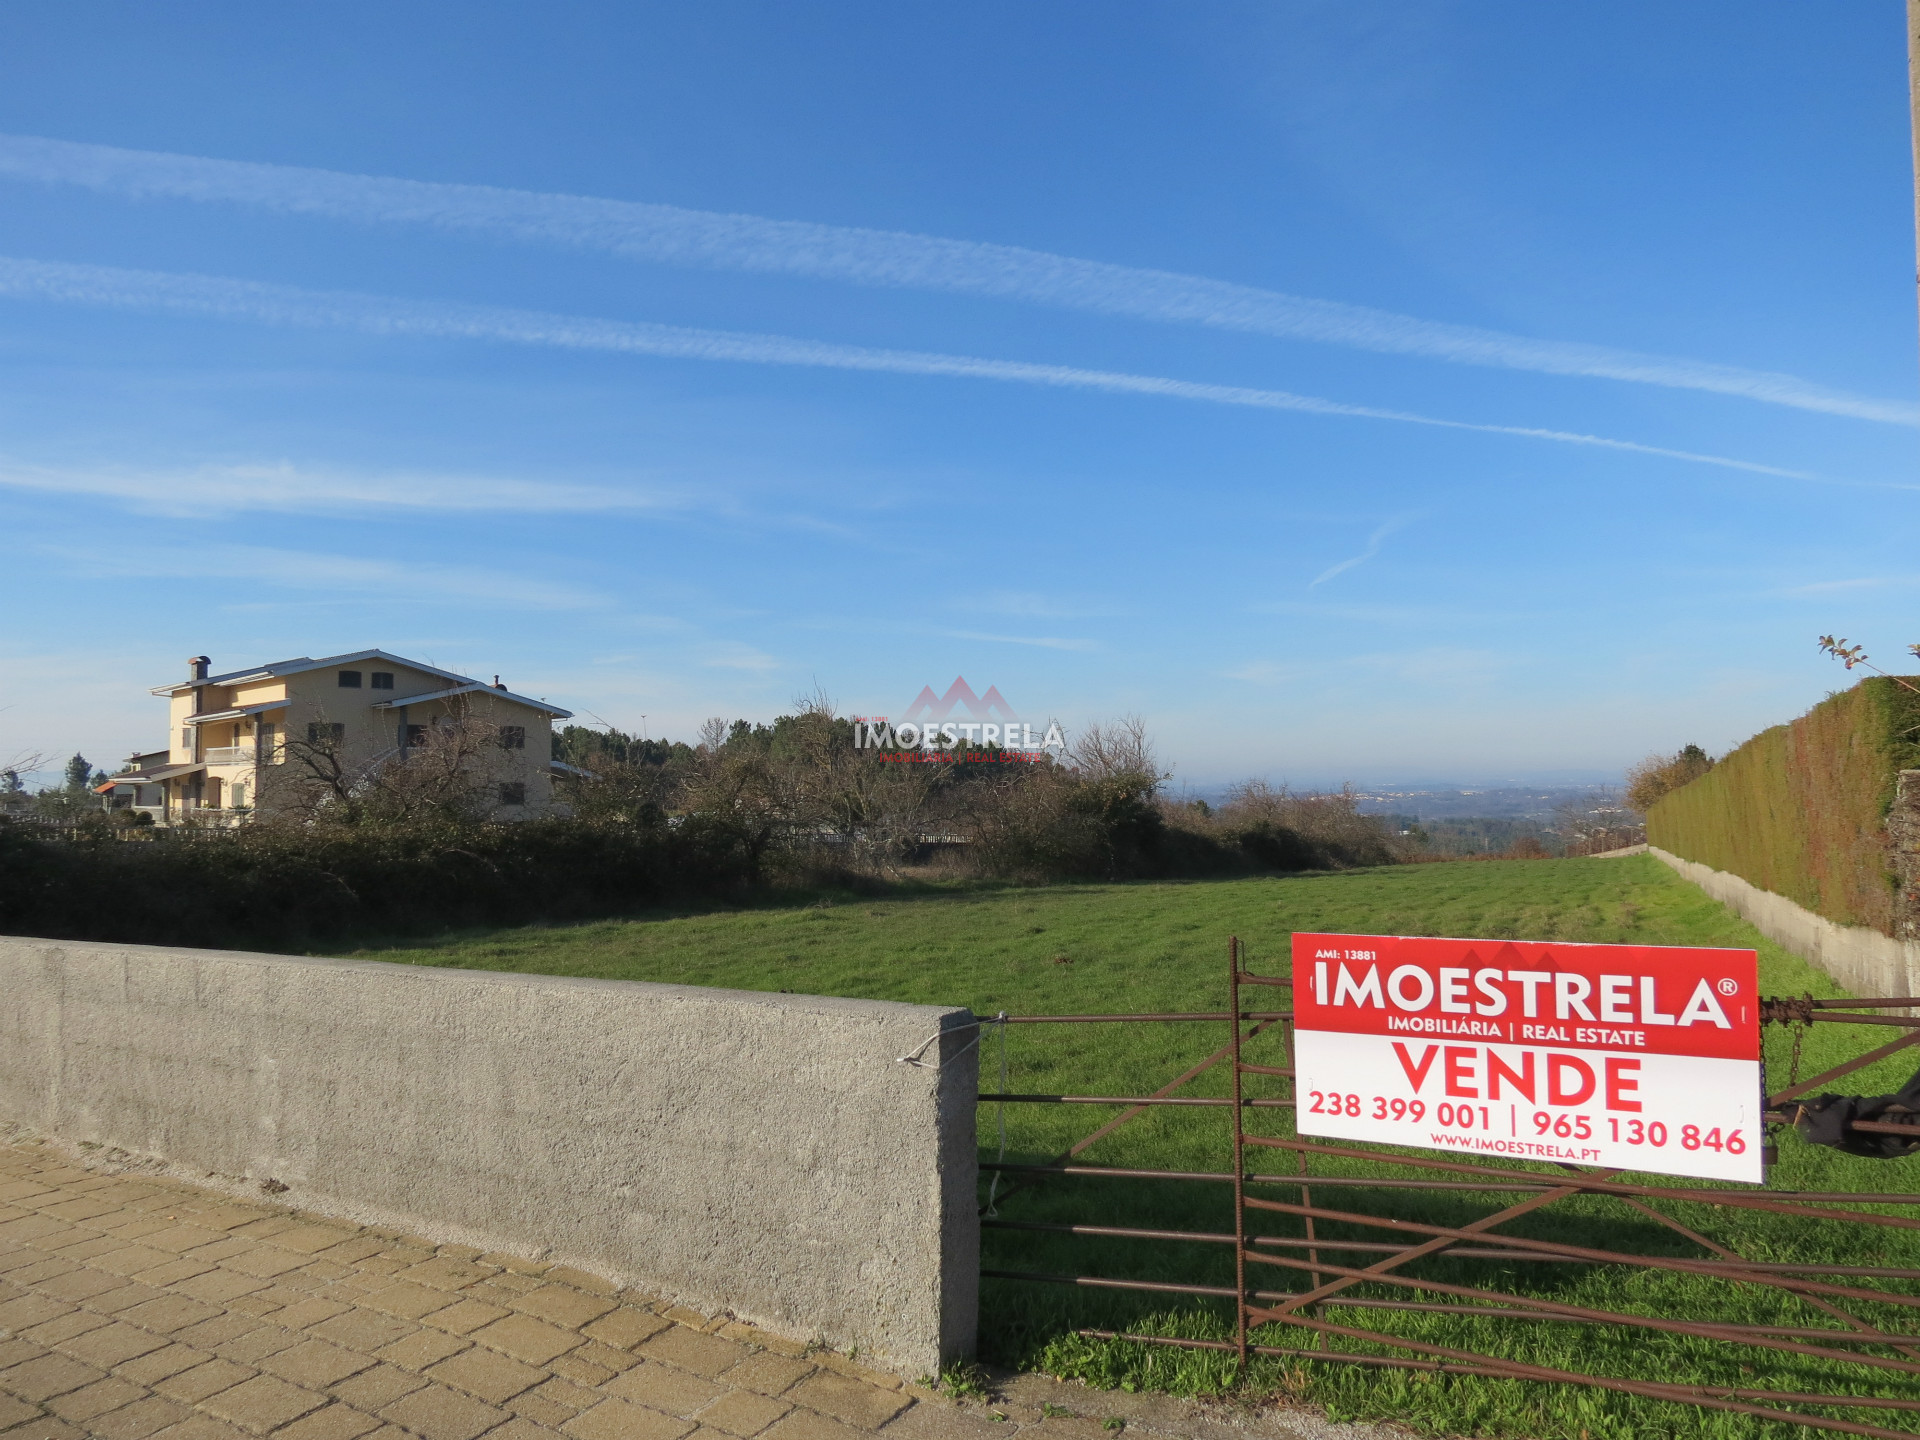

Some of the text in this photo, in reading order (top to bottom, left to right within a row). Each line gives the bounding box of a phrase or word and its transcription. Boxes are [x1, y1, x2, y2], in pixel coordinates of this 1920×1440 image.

[1315, 949, 1376, 961] AMI: 13881
[1388, 1016, 1646, 1046] IMOBILIÁRIA REAL ESTATE
[1391, 1042, 1642, 1113] VENDE
[1309, 1091, 1746, 1155] 238 399 001 965 130 846
[1430, 1133, 1601, 1162] WWW.IMOESTRELA.PT
